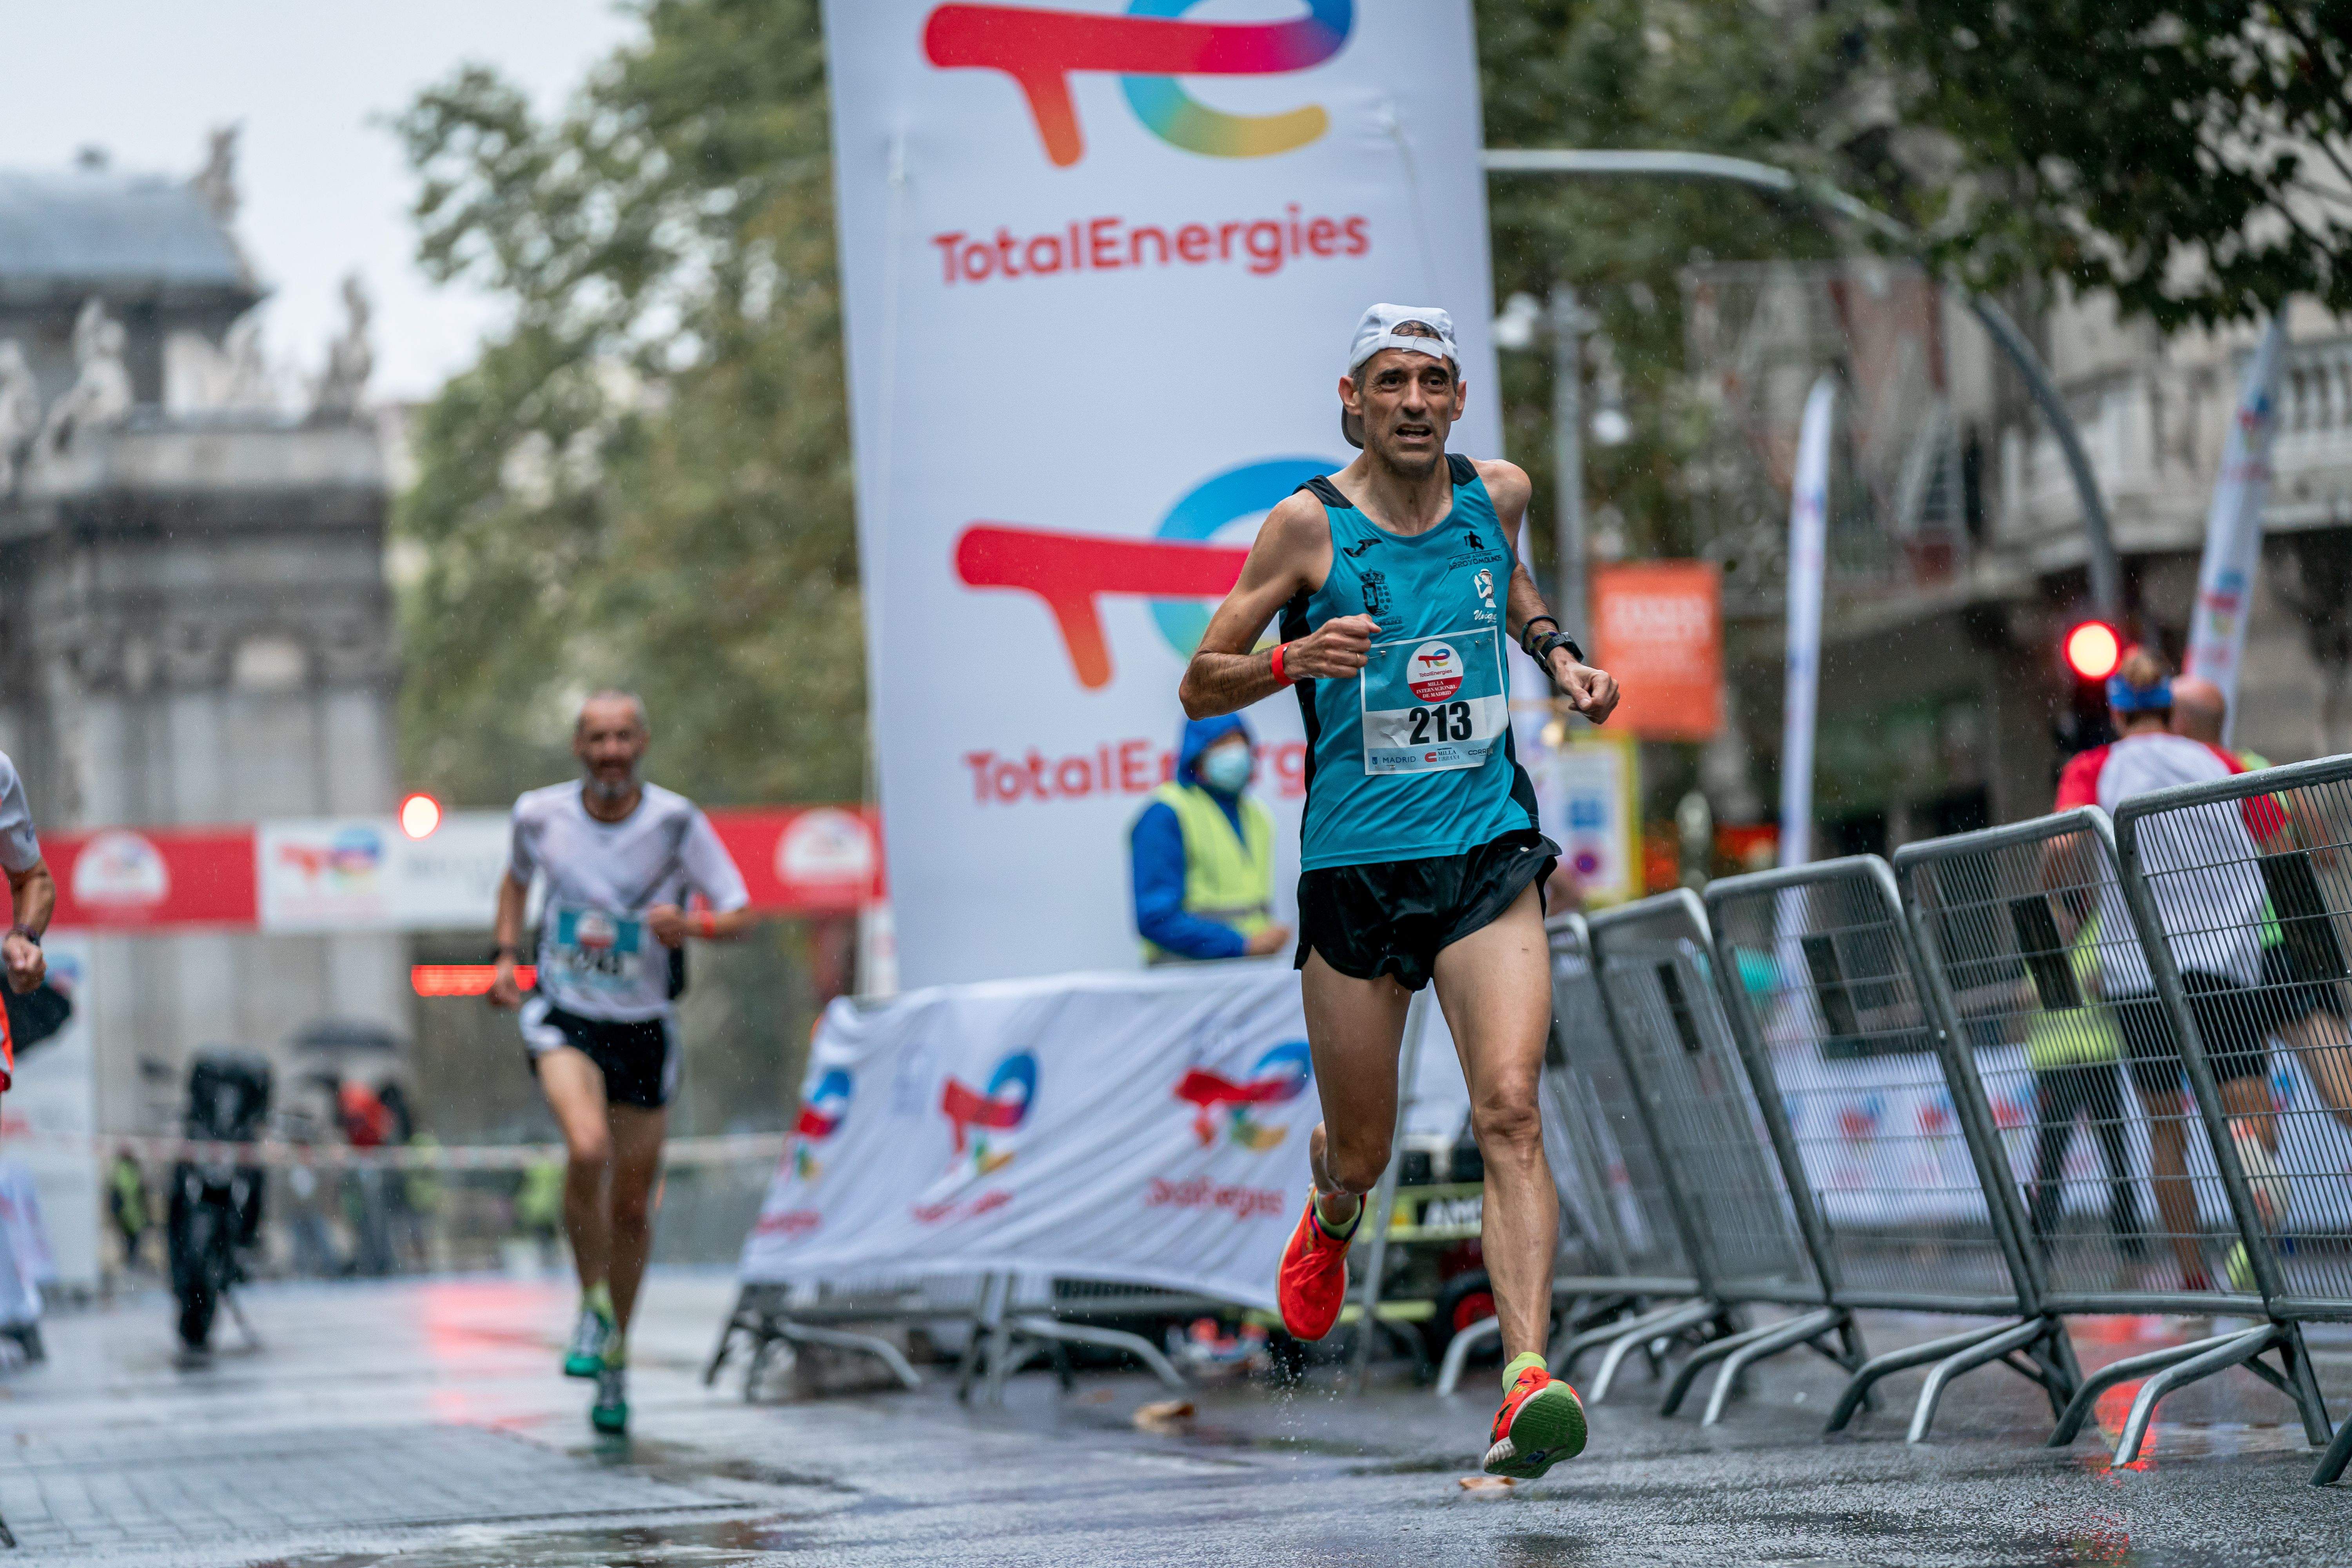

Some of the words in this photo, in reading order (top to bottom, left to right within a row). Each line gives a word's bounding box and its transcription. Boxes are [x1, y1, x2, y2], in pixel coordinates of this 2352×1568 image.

[932, 201, 1371, 286] TotalEnergies
[1449, 554, 1503, 570] ARROYOMOLINOS
[1419, 669, 1452, 678] TotalEnergies
[1416, 684, 1457, 694] INTERNACIONAL
[1409, 701, 1472, 745] 213
